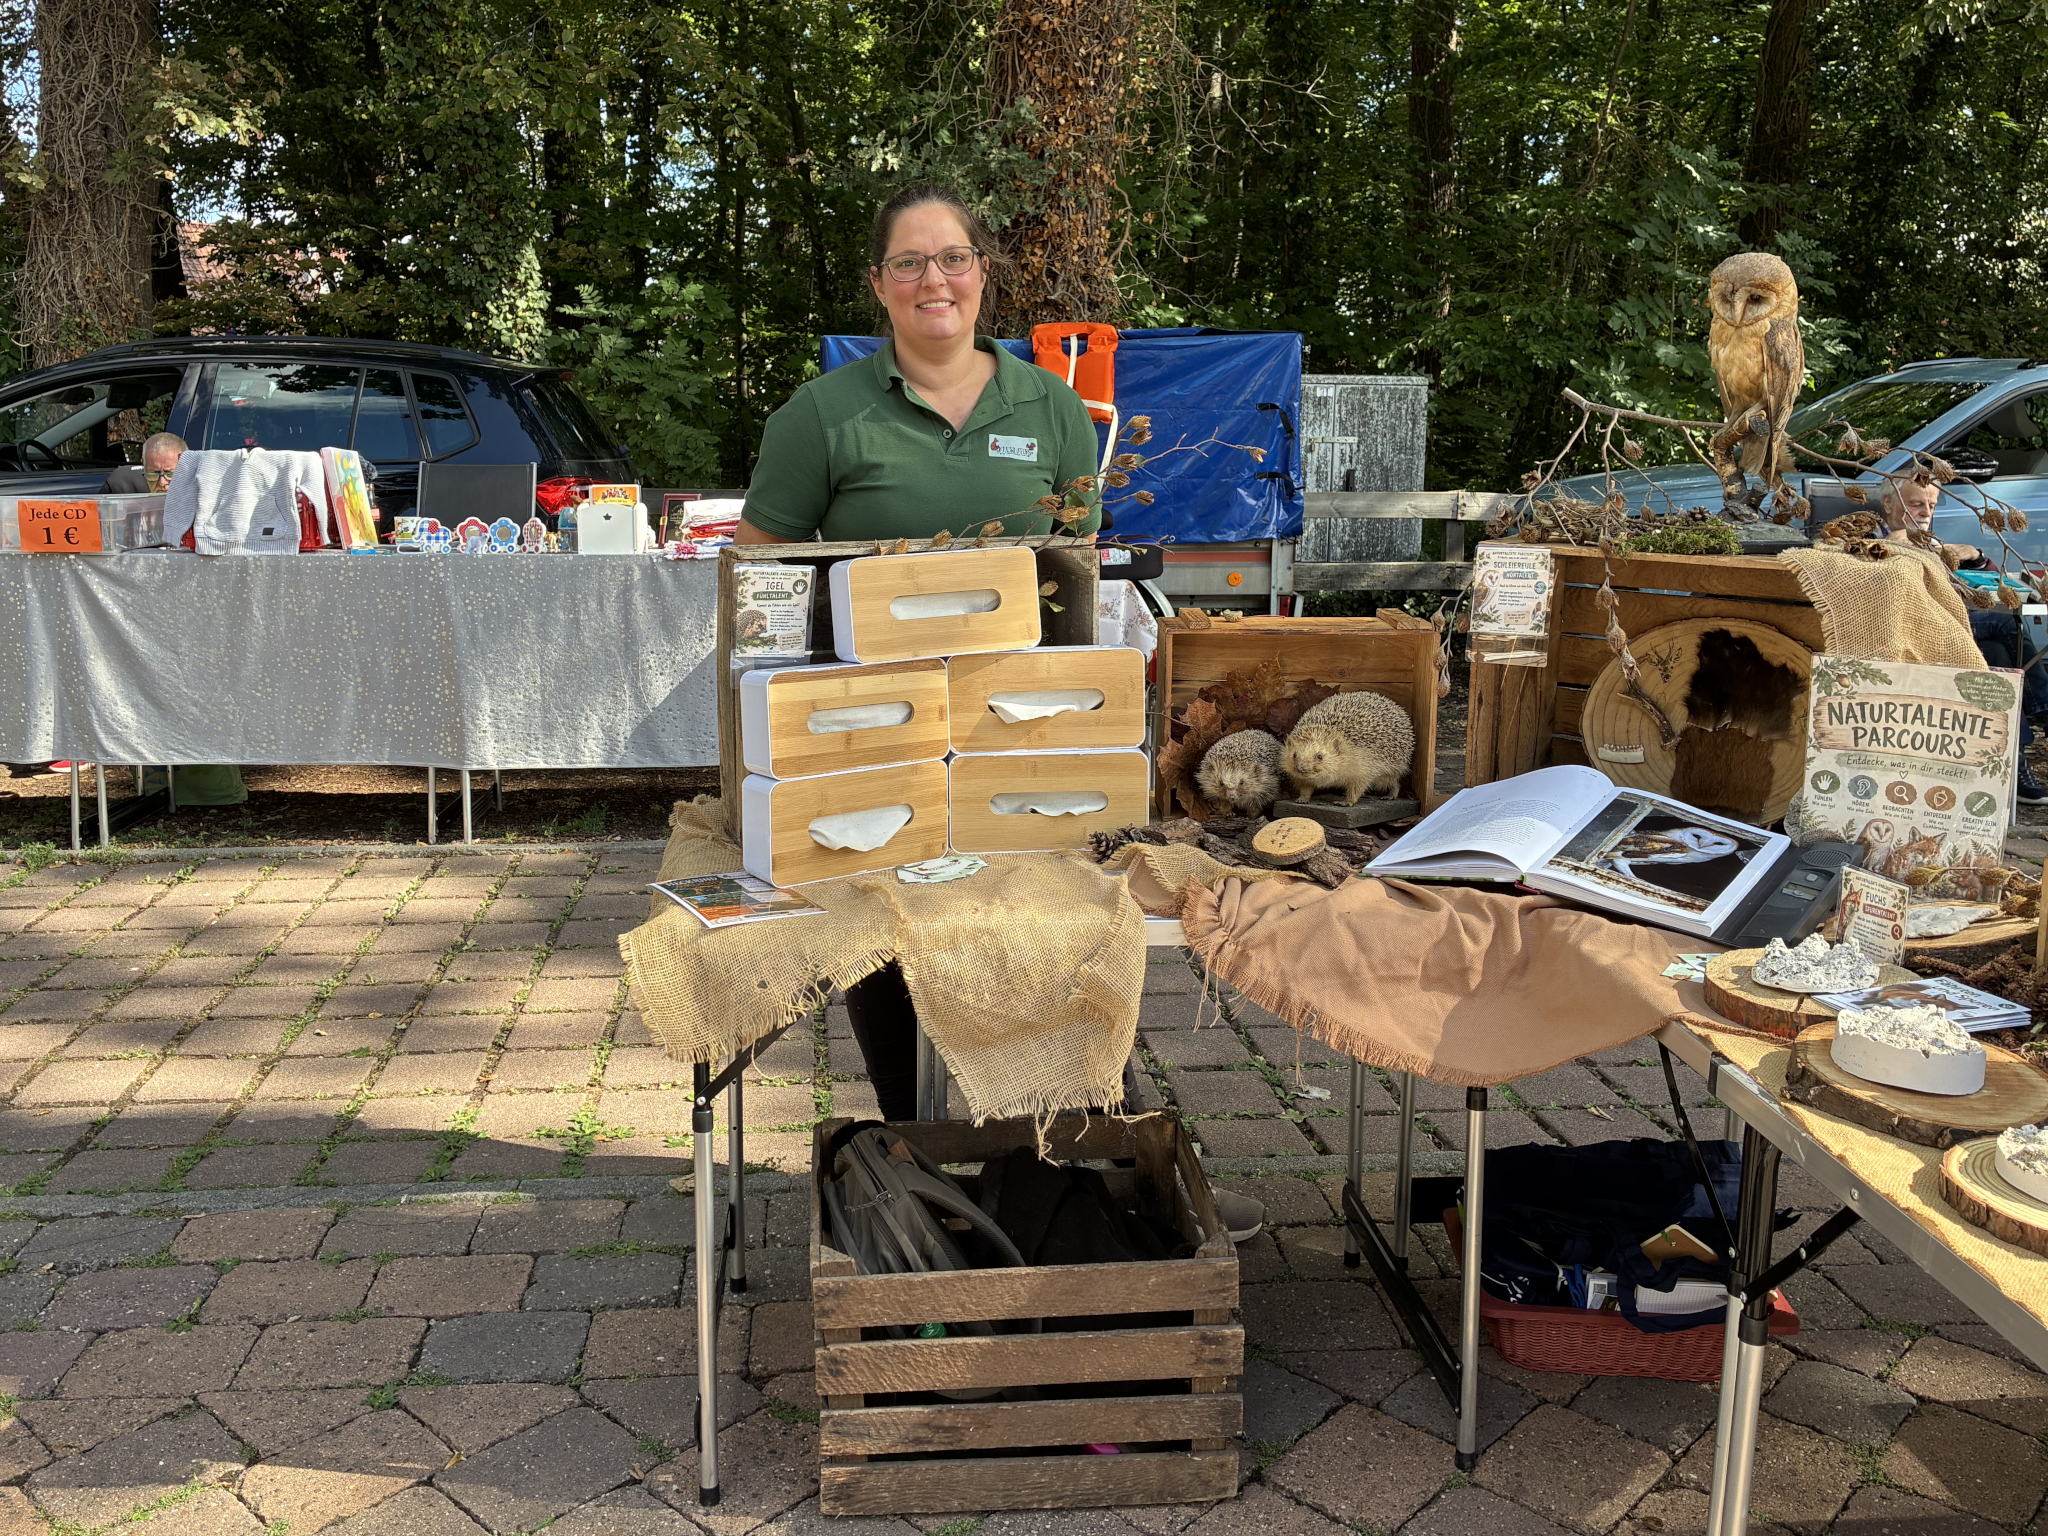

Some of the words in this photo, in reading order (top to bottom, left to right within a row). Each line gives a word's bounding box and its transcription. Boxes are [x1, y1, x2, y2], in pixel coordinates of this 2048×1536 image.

[28, 508, 60, 522] Jede
[63, 508, 87, 520] CD
[42, 526, 56, 545] 1
[63, 526, 80, 545] €
[1493, 561, 1536, 570] SCHLEIEREULE
[765, 581, 785, 590] IGEL
[1827, 701, 2003, 740] NATURTALENTE-
[1852, 726, 1967, 760] PARCOURS
[1846, 754, 1887, 768] Entdecke,
[1890, 761, 1906, 769] was
[1909, 760, 1917, 770] in
[1920, 762, 1933, 773] dir
[1936, 768, 1968, 780] steckt!
[1814, 794, 1833, 802] FÜHLEN
[1882, 804, 1915, 814] BEOBACHTEN
[1923, 810, 1952, 820] ENTDECKEN
[1962, 816, 1984, 825] KREATIV
[1985, 819, 1997, 827] SEIN
[1865, 891, 1887, 907] FUCHS
